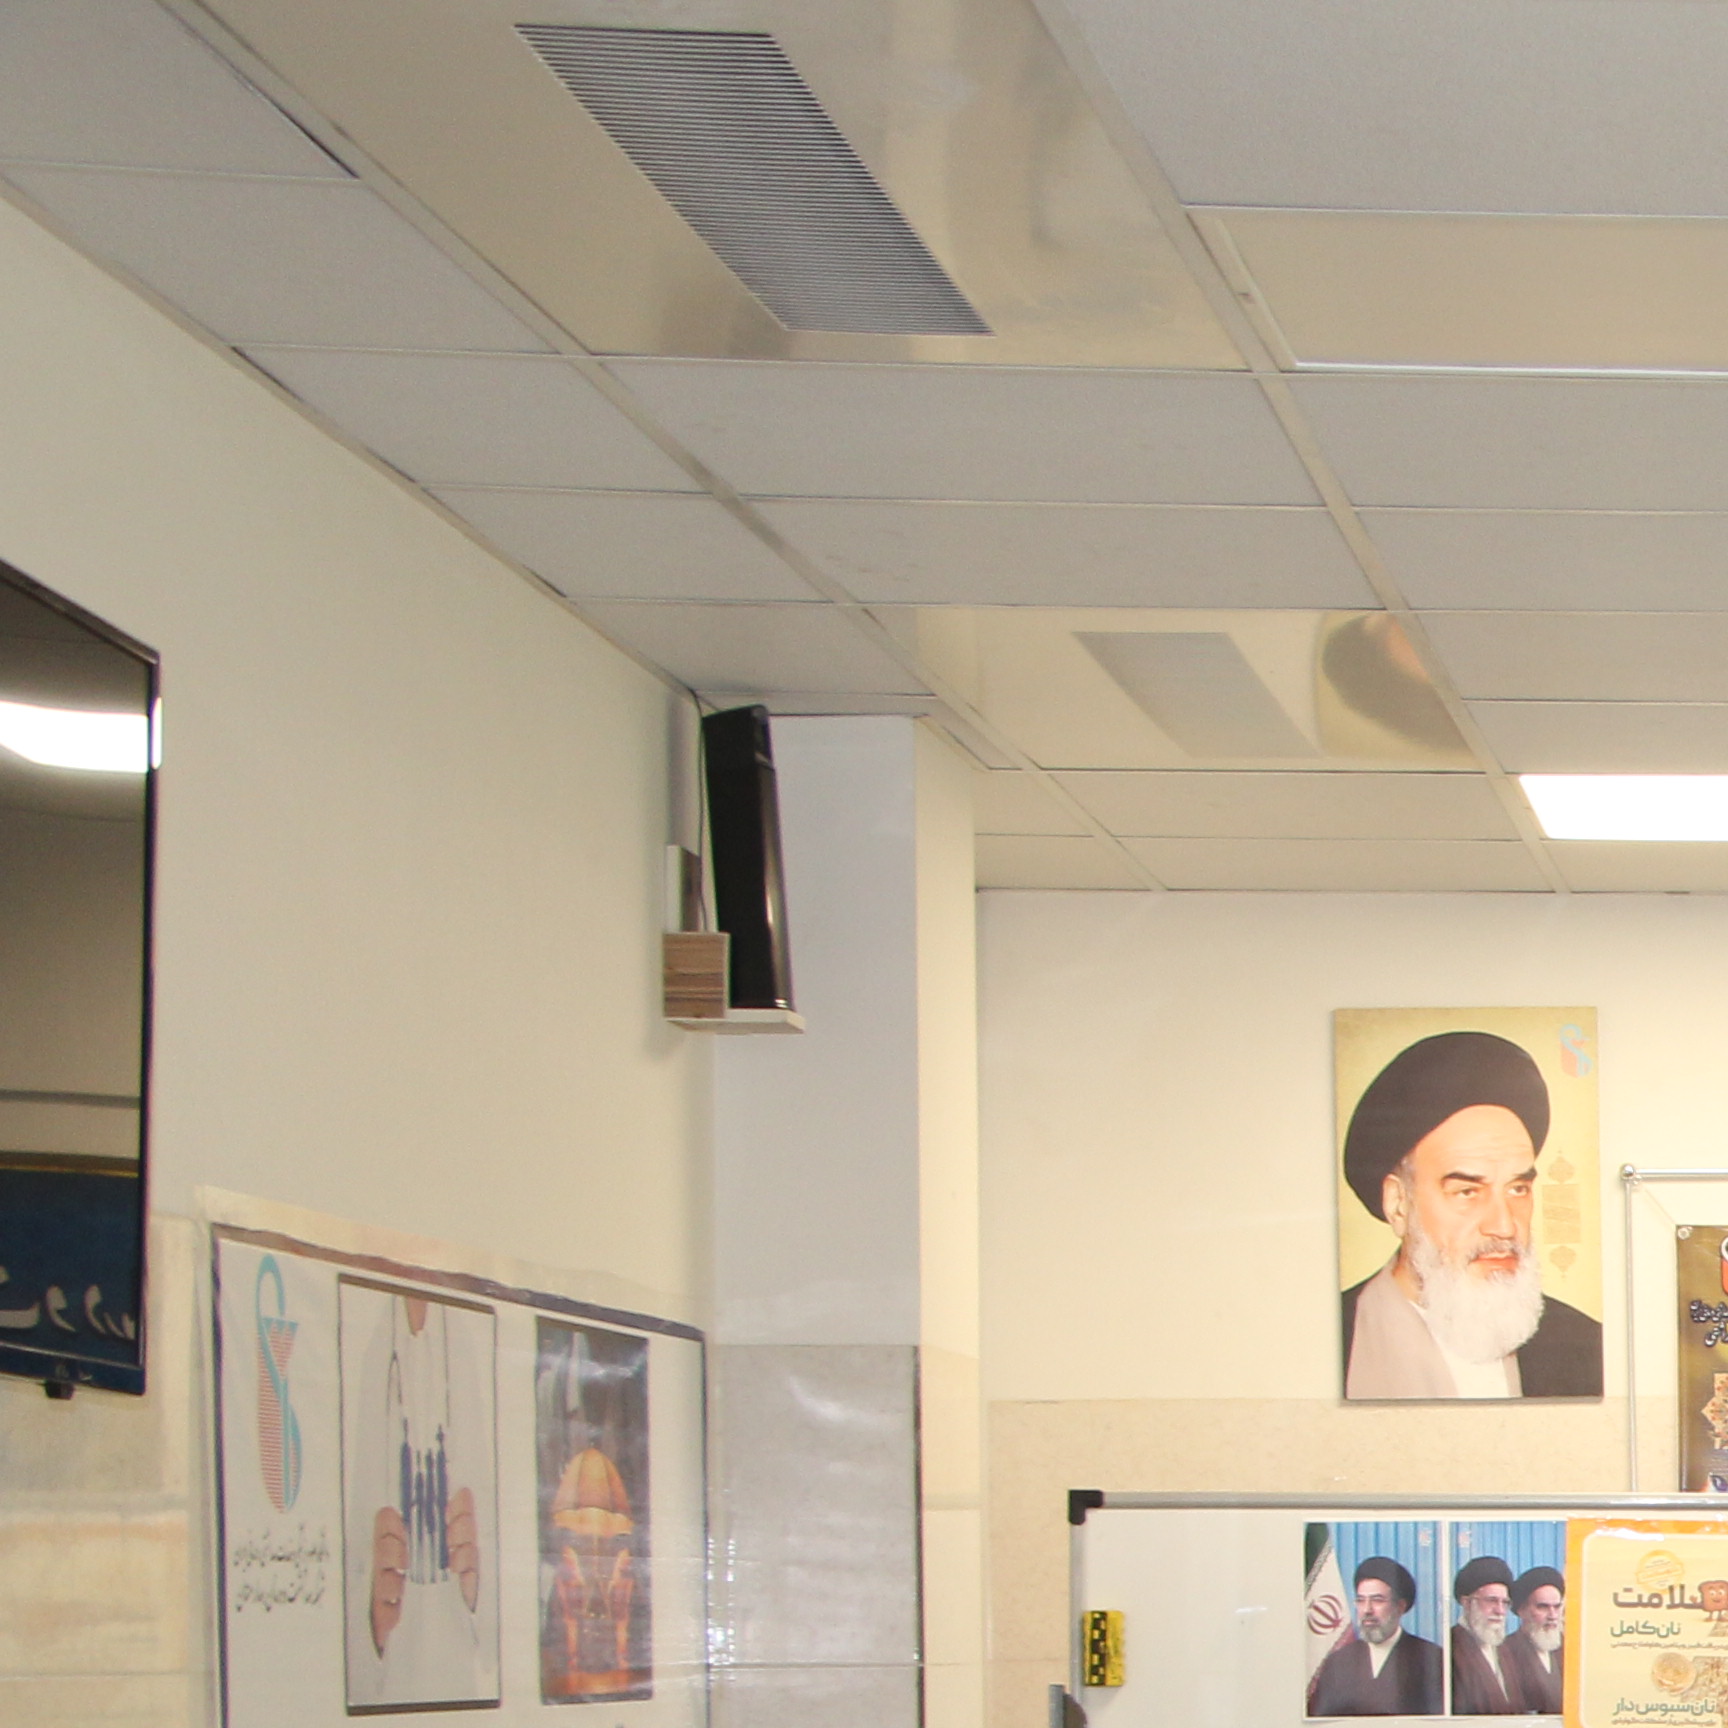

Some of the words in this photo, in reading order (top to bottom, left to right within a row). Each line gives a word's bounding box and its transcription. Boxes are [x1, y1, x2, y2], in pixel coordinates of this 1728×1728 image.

[1610, 1619, 1657, 1638] کامل
[1657, 1621, 1681, 1638] نان
[1612, 1697, 1635, 1716] دار
[1636, 1703, 1690, 1718] سبوس
